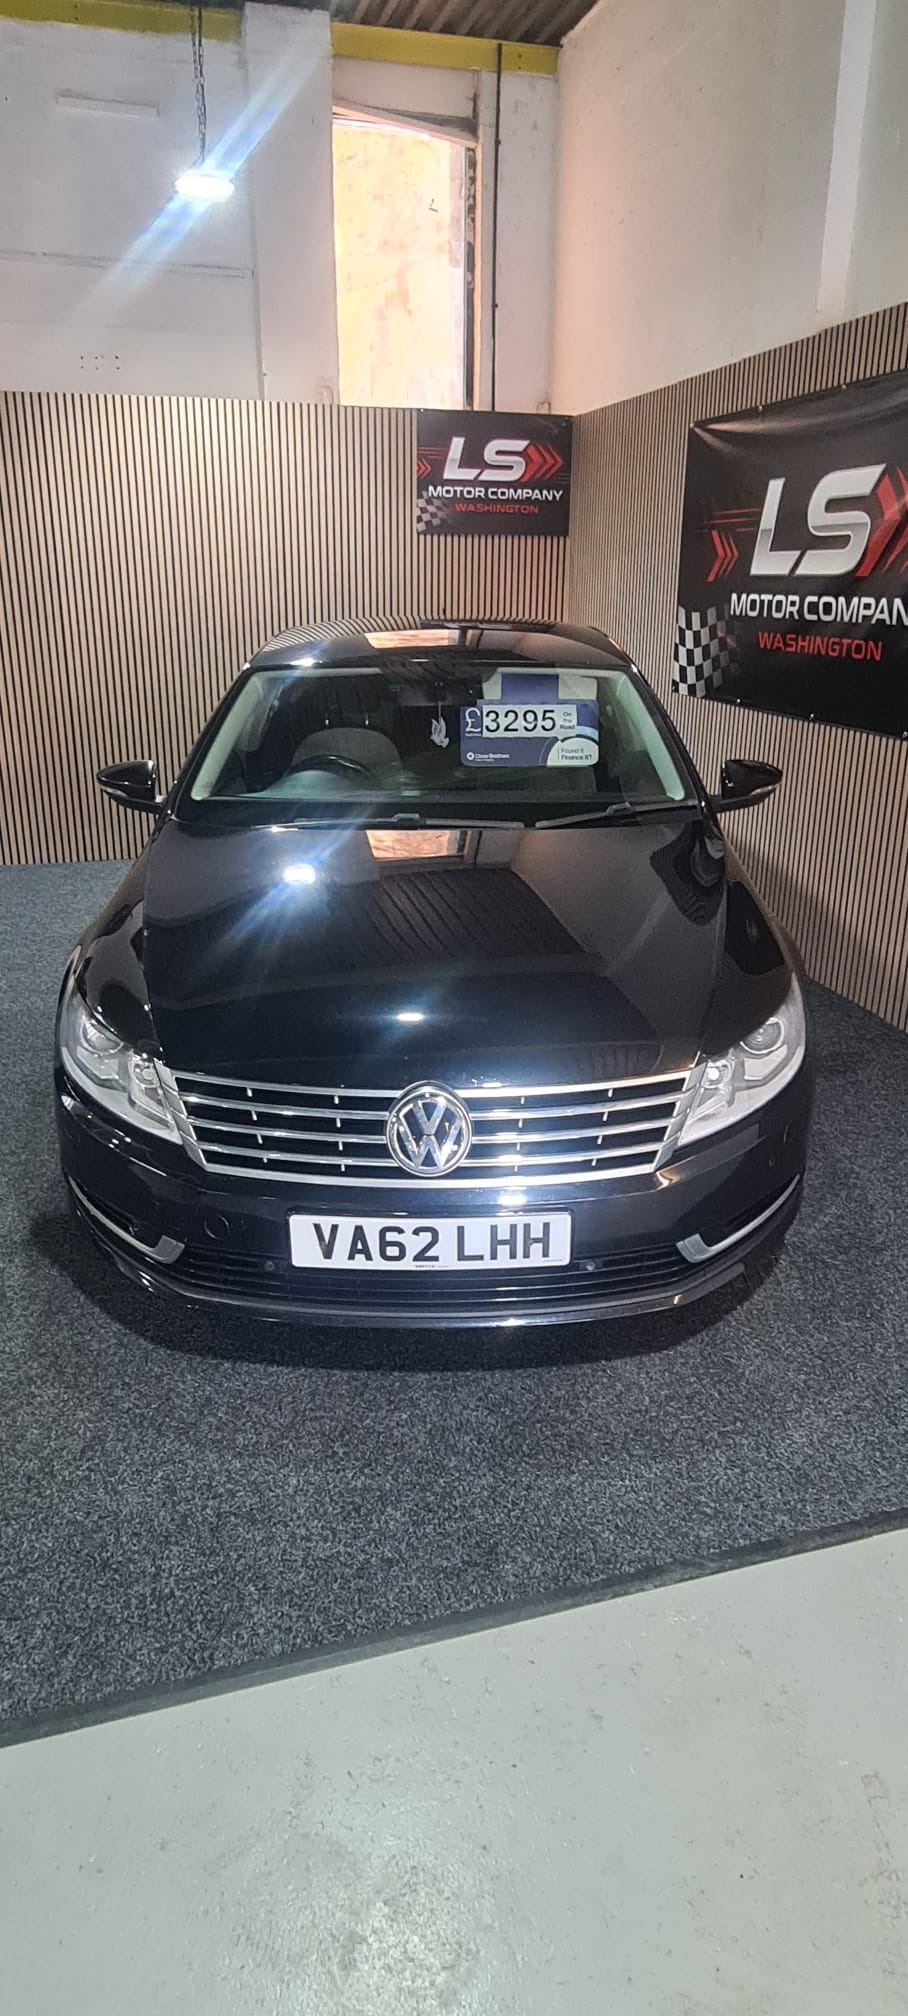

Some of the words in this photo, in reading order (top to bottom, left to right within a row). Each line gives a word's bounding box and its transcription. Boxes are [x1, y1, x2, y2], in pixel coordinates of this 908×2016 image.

[443, 436, 530, 482] LS
[428, 485, 485, 499] MOTOR
[488, 488, 563, 501] COMPANY
[454, 503, 539, 514] WASHINGTON
[750, 464, 886, 577] LS
[730, 592, 799, 620] MOTOR
[758, 631, 882, 661] WASHINGTON
[313, 1222, 440, 1263] VA62
[457, 1221, 551, 1262] LHH
